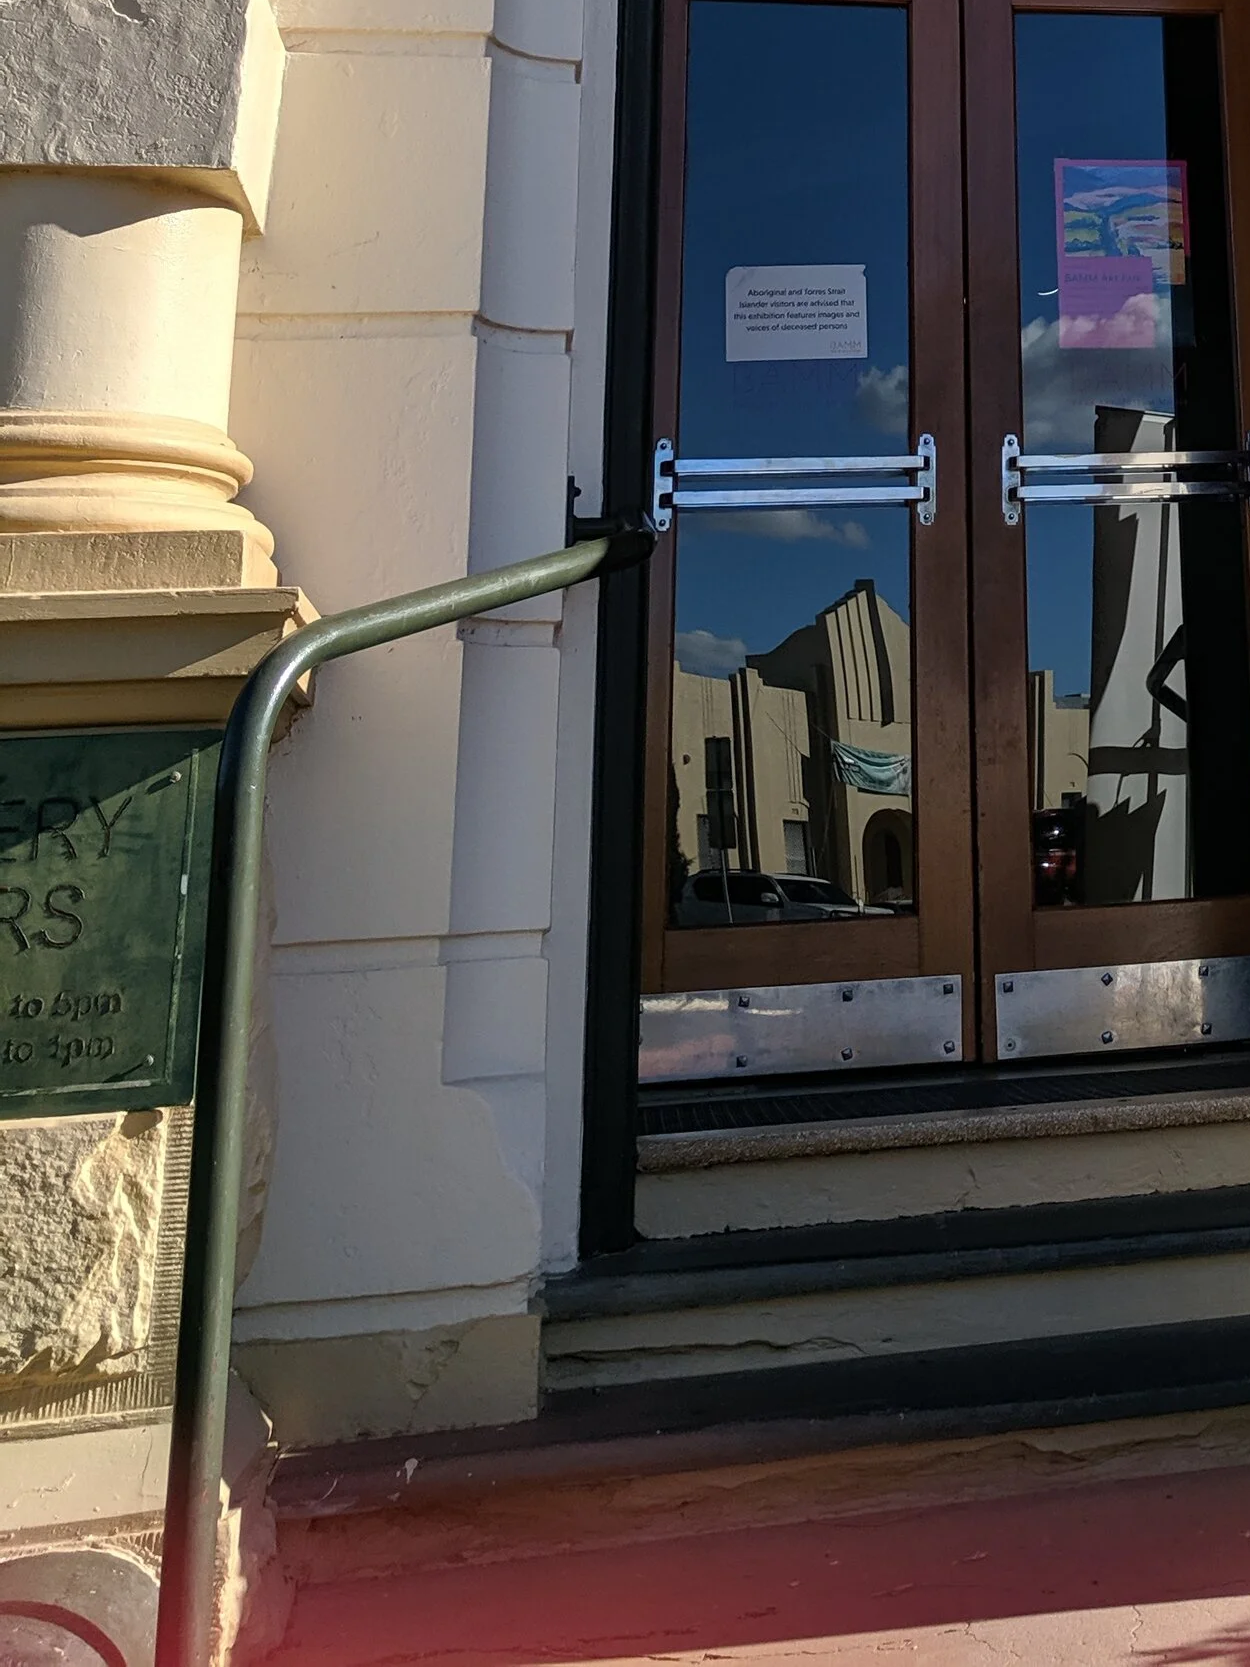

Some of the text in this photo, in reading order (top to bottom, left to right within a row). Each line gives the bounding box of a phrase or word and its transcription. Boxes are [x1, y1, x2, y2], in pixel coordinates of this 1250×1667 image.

[747, 288, 787, 298] Aboriginal
[788, 288, 803, 296] and
[827, 287, 846, 296] Strait
[739, 299, 855, 309] Islander visitors are advised that
[734, 310, 861, 320] this exhibition features images and
[745, 322, 848, 332] voices of deceased persons
[9, 992, 45, 1019] to
[3, 1038, 33, 1065] to
